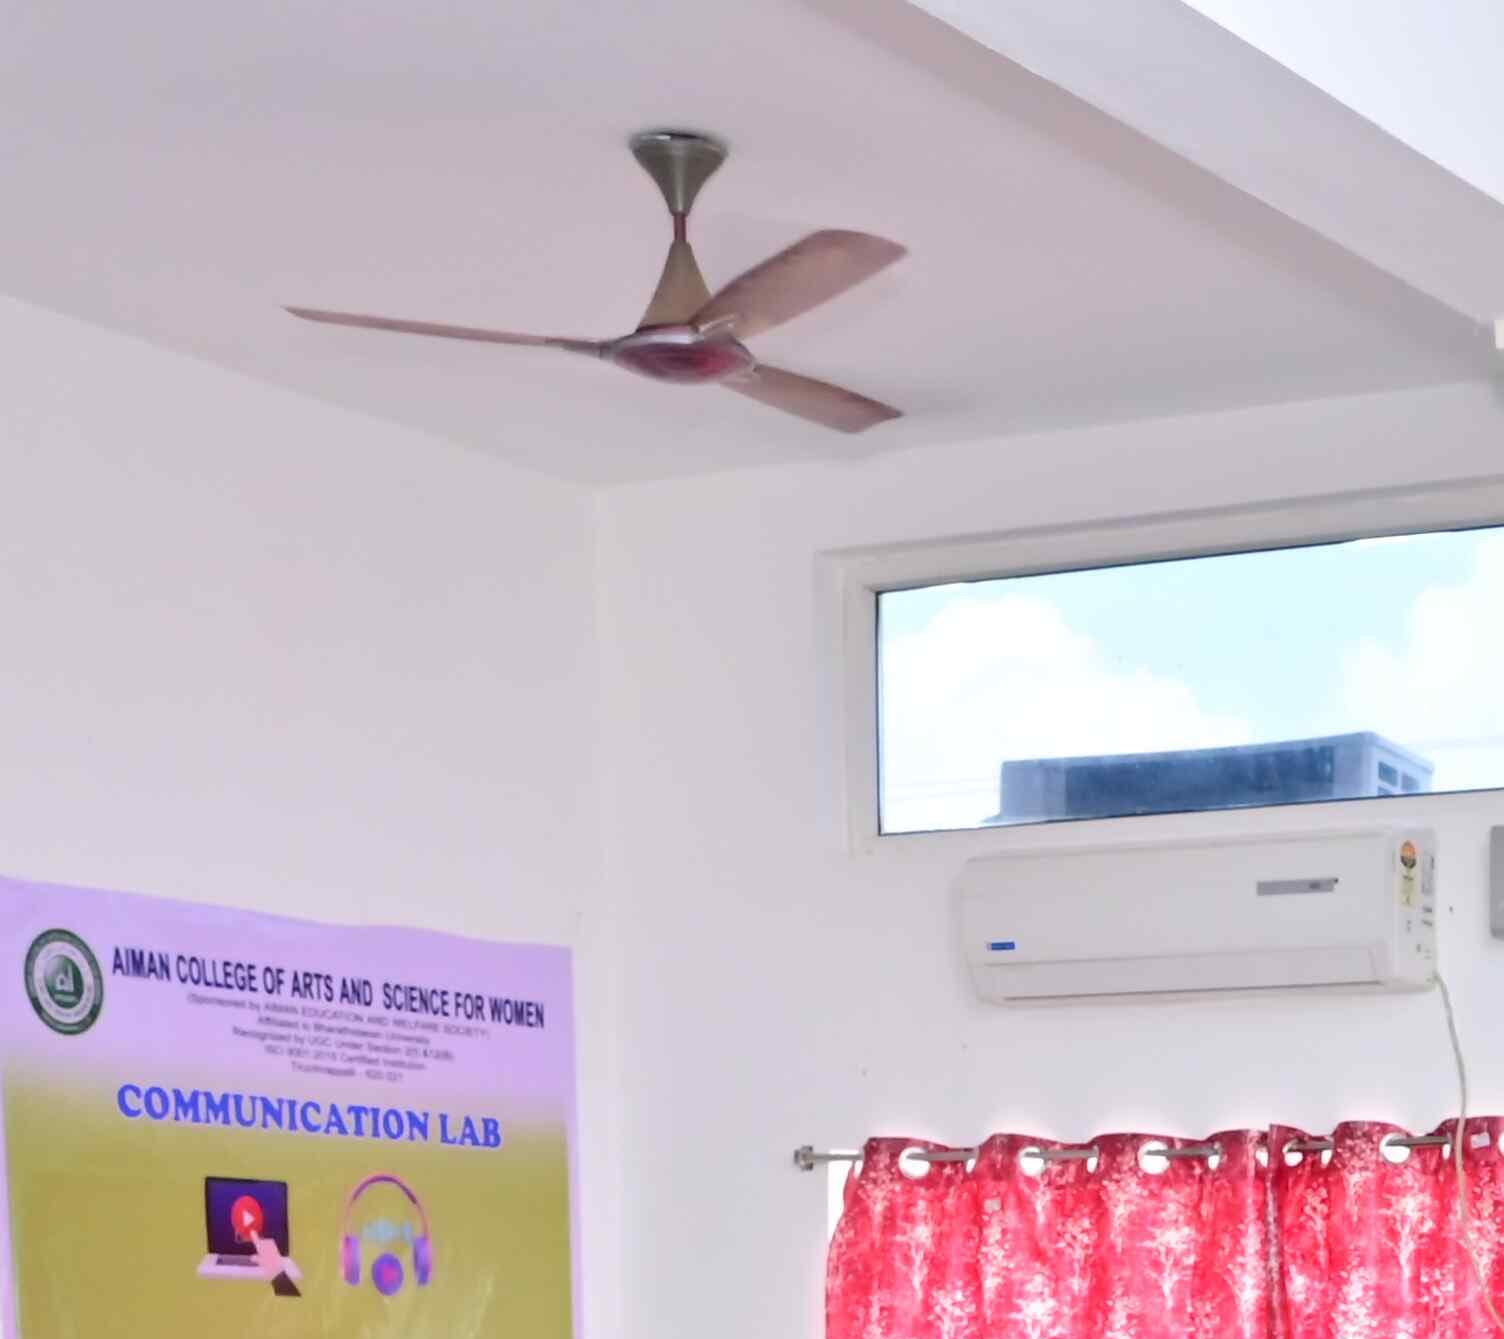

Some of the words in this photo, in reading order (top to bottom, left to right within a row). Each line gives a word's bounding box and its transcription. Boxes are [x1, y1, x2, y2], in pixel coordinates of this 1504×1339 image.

[113, 947, 170, 981] AIMAN
[176, 955, 258, 992] COLLEGE
[263, 966, 285, 994] OF
[291, 970, 333, 1003] ARTS
[339, 977, 373, 1007] AND
[383, 982, 450, 1017] SCIENCE
[455, 992, 485, 1021] FOR
[489, 996, 544, 1028] WOMEN
[117, 1083, 429, 1142] COMMUNICATION
[439, 1113, 501, 1148] LAB
